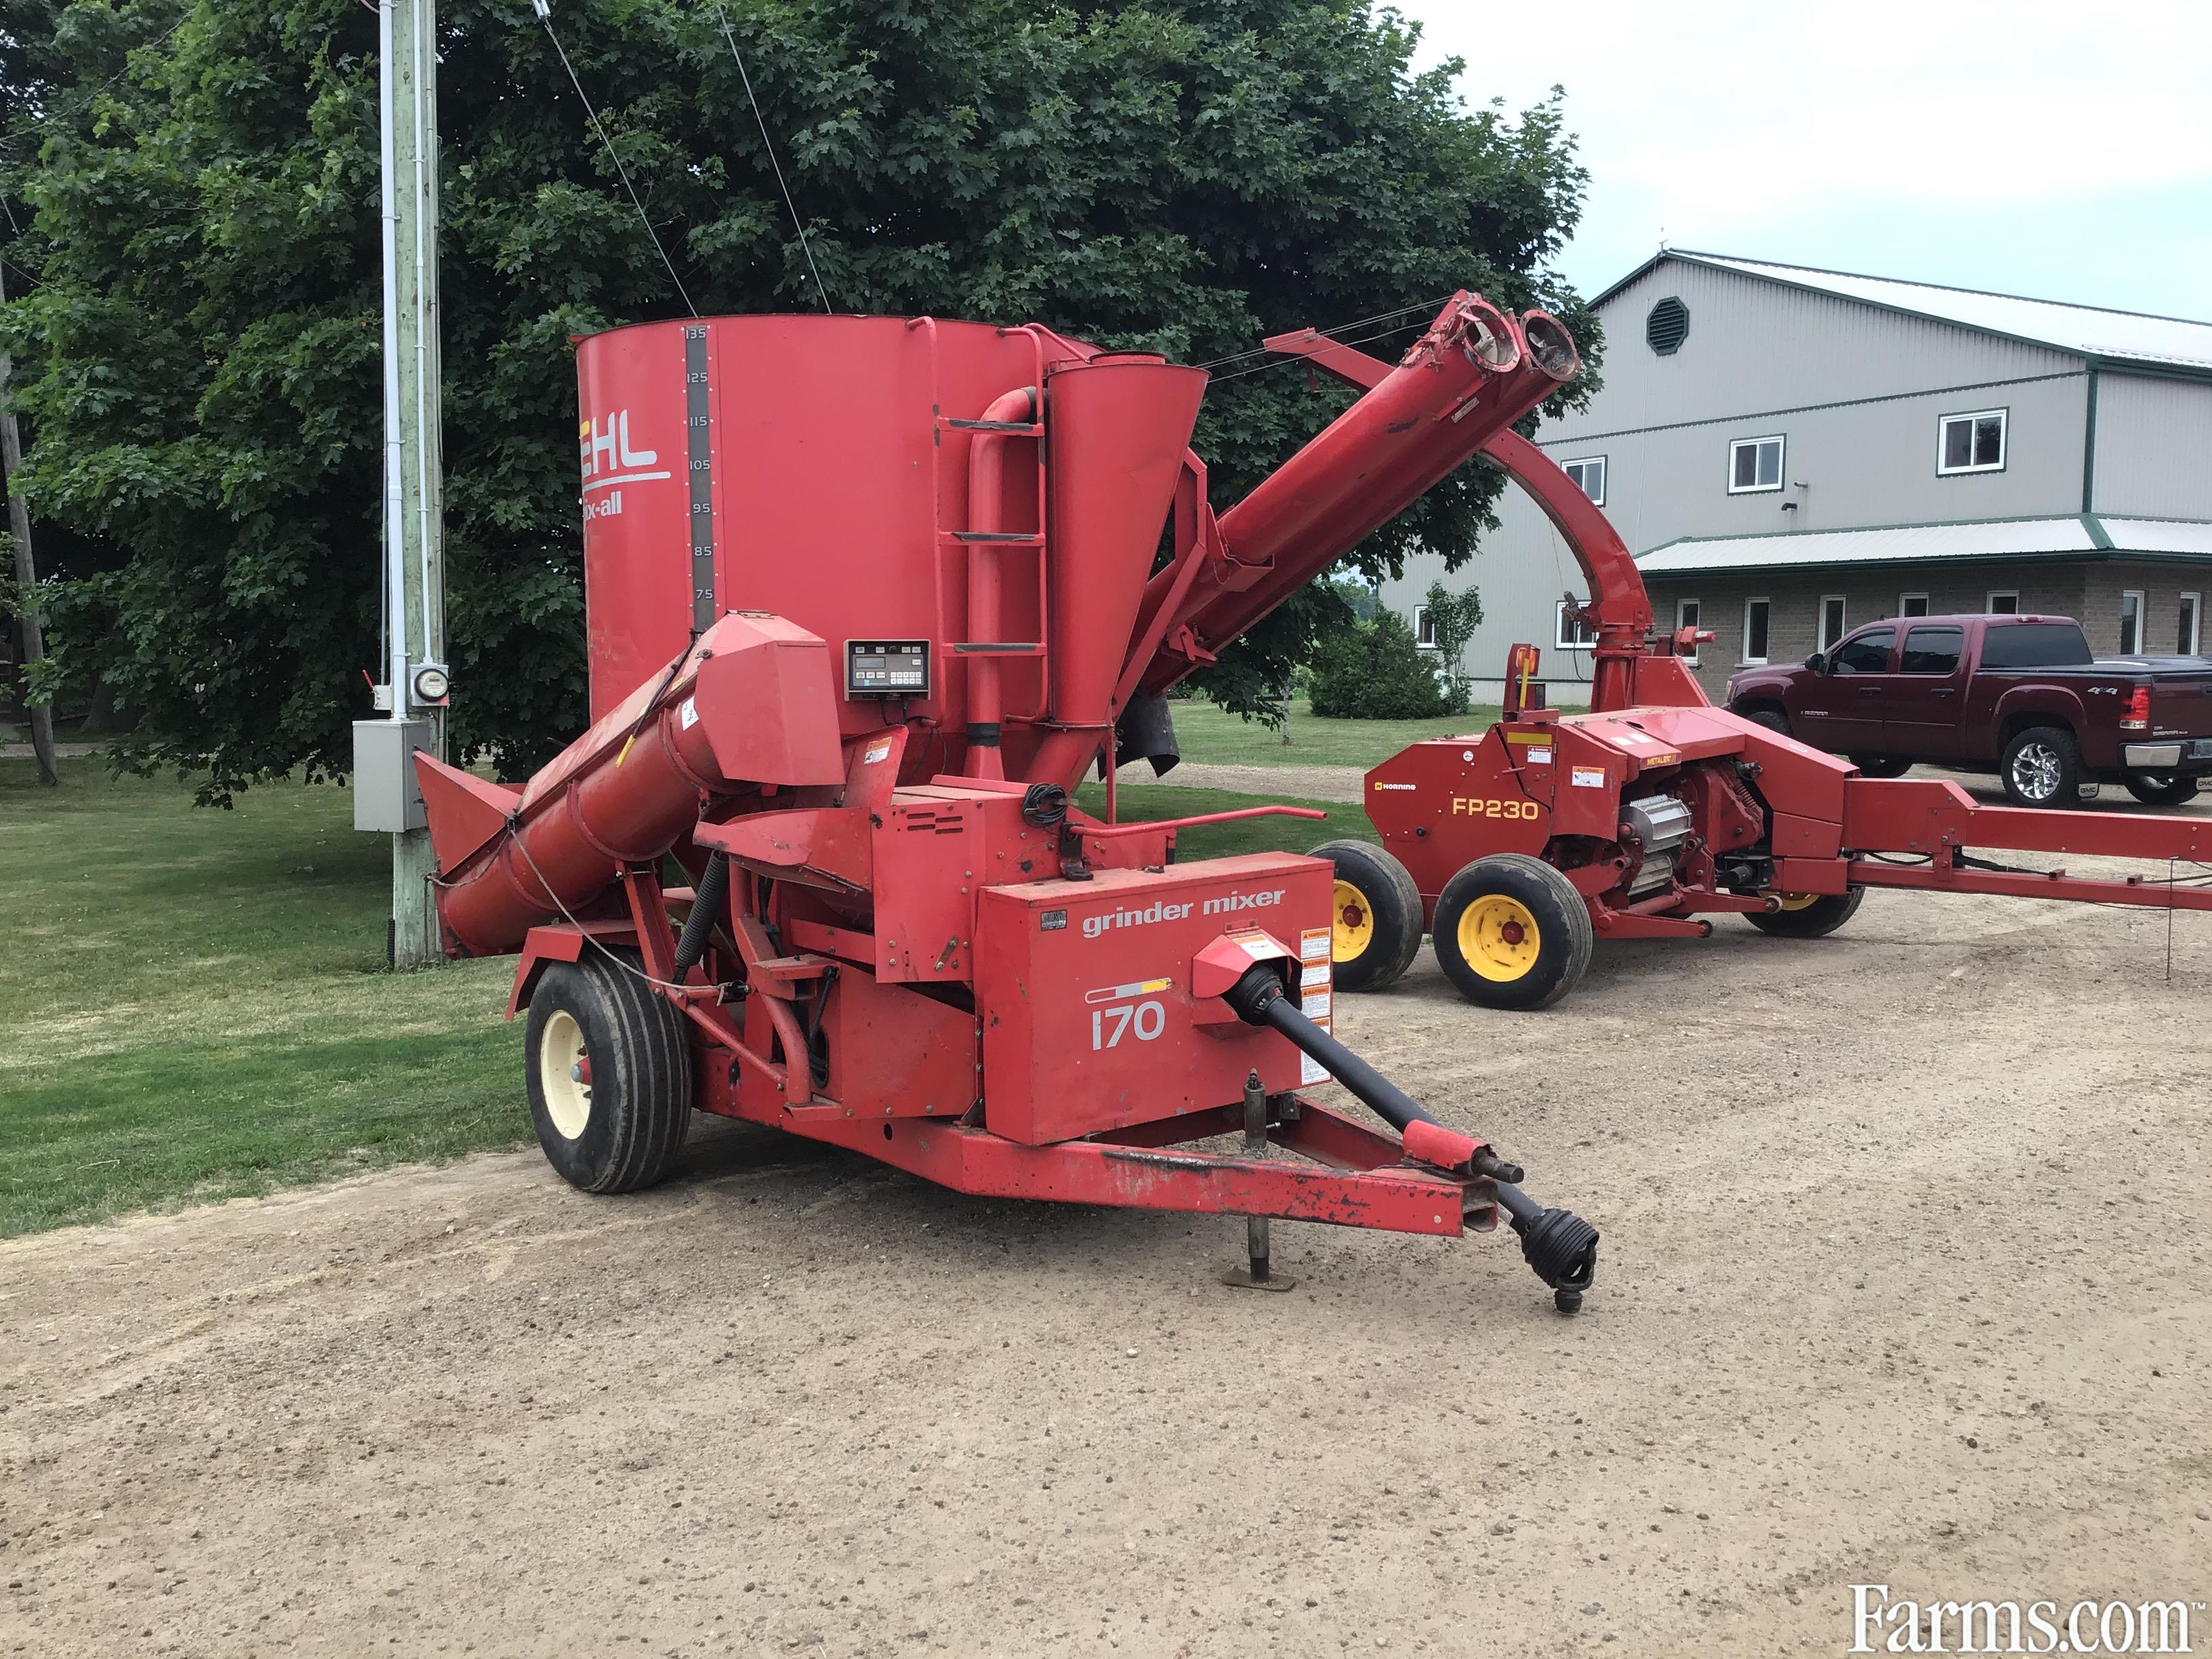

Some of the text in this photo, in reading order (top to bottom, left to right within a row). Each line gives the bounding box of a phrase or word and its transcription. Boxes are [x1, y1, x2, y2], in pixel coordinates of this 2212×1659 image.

[686, 328, 706, 340] 135
[687, 372, 708, 384] 125
[690, 416, 708, 427] 115
[689, 459, 710, 470] 105
[693, 503, 710, 514] 95
[694, 546, 712, 556] 85
[695, 589, 713, 600] 75
[1453, 798, 1538, 820] FP230
[1082, 901, 1194, 939] grinder
[1203, 889, 1286, 916] mixer
[1092, 1000, 1166, 1050] 170
